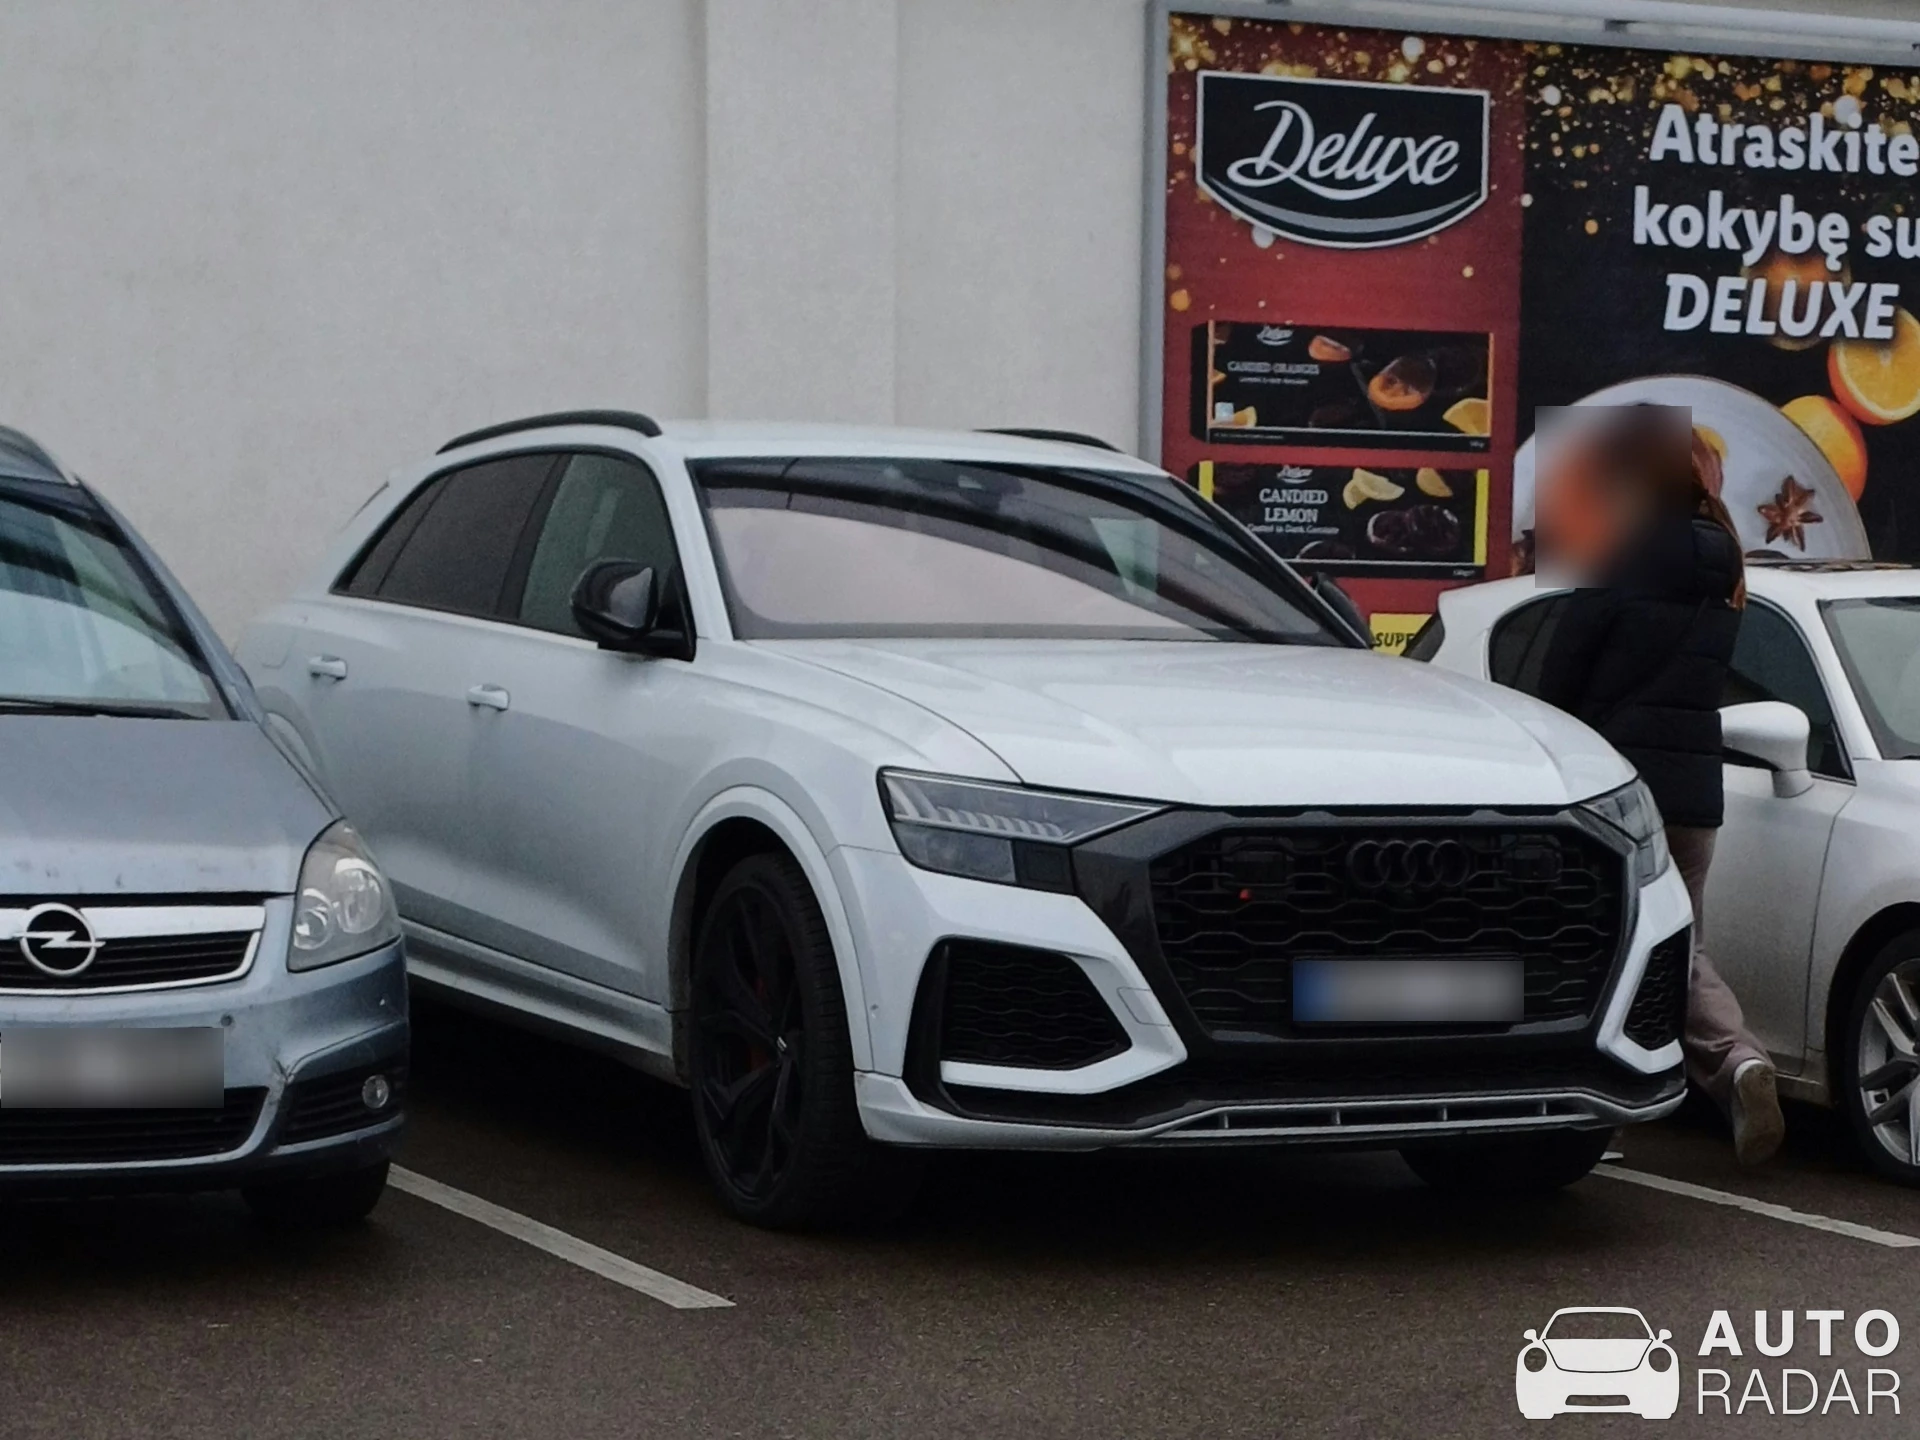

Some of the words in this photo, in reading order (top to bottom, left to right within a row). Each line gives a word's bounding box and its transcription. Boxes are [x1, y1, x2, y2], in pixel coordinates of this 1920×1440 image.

[1226, 100, 1460, 200] Deluxe
[1649, 103, 1920, 176] Atraskite
[1633, 185, 1850, 271] kokybę
[1865, 215, 1920, 259] su
[1663, 273, 1900, 339] DELUXE
[1259, 488, 1328, 504] CANDIED
[1264, 507, 1319, 523] LEMON
